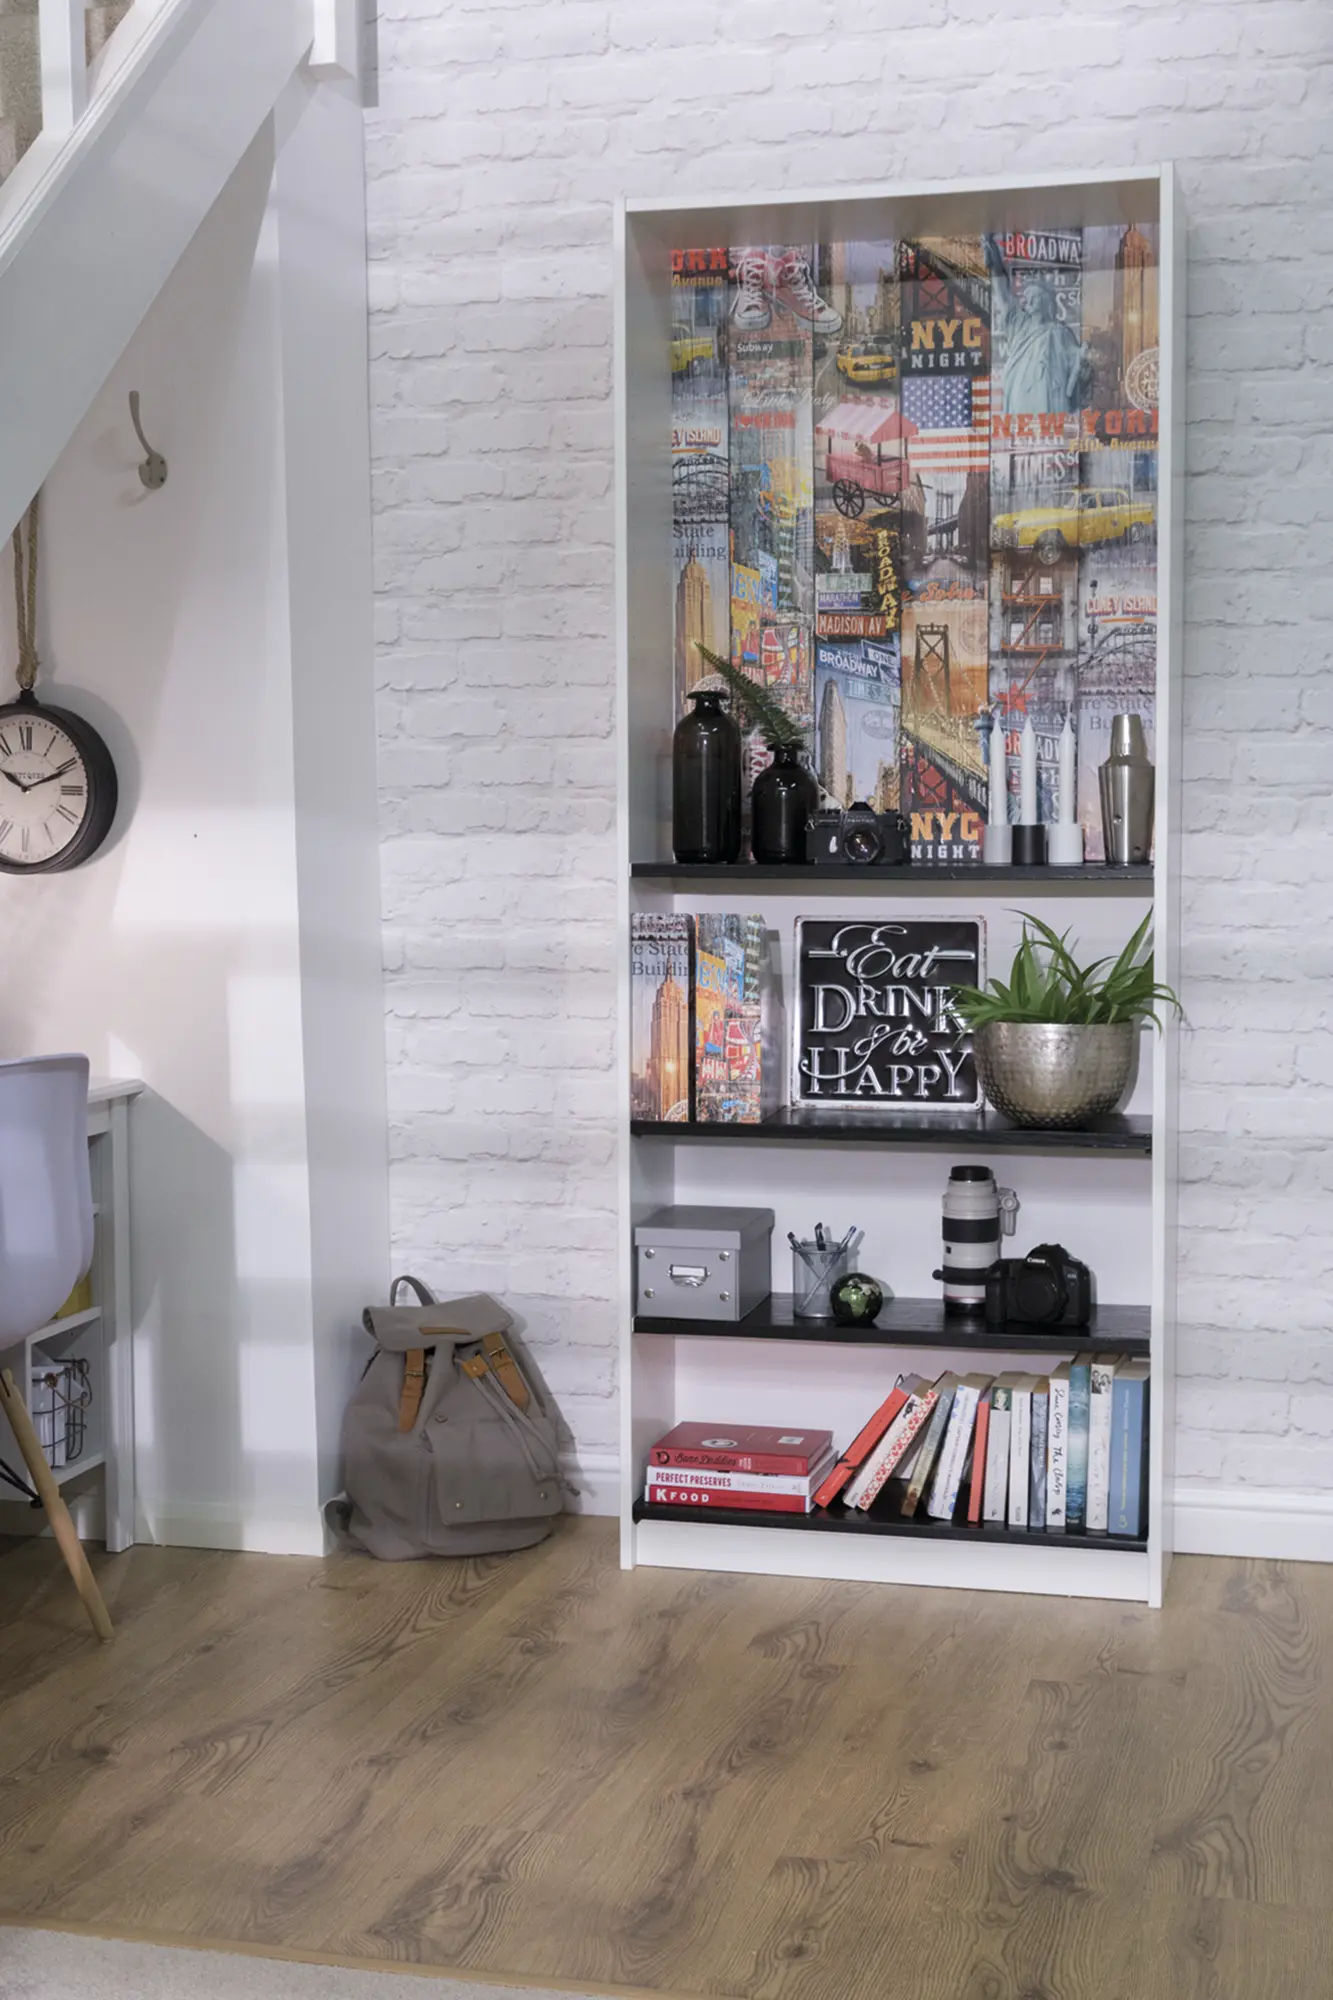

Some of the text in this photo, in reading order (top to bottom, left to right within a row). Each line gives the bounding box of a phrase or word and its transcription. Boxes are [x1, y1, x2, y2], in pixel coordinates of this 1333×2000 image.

[737, 342, 773, 353] Subway
[911, 318, 981, 349] NYC
[911, 351, 983, 368] NIGHT
[685, 428, 721, 447] ISLAND
[992, 411, 1066, 439] NEW
[1014, 451, 1066, 481] TIMES
[672, 524, 715, 539] State
[819, 615, 882, 634] MADISON AV
[819, 648, 878, 677] BROADWAY
[910, 812, 979, 841] NYC
[910, 844, 980, 859] NIGHT
[808, 984, 975, 1034] DRINK
[892, 1023, 929, 1056] be
[803, 1046, 975, 1098] HAPPY
[656, 1472, 688, 1485] PERFECT
[689, 1475, 732, 1488] PRESERVES
